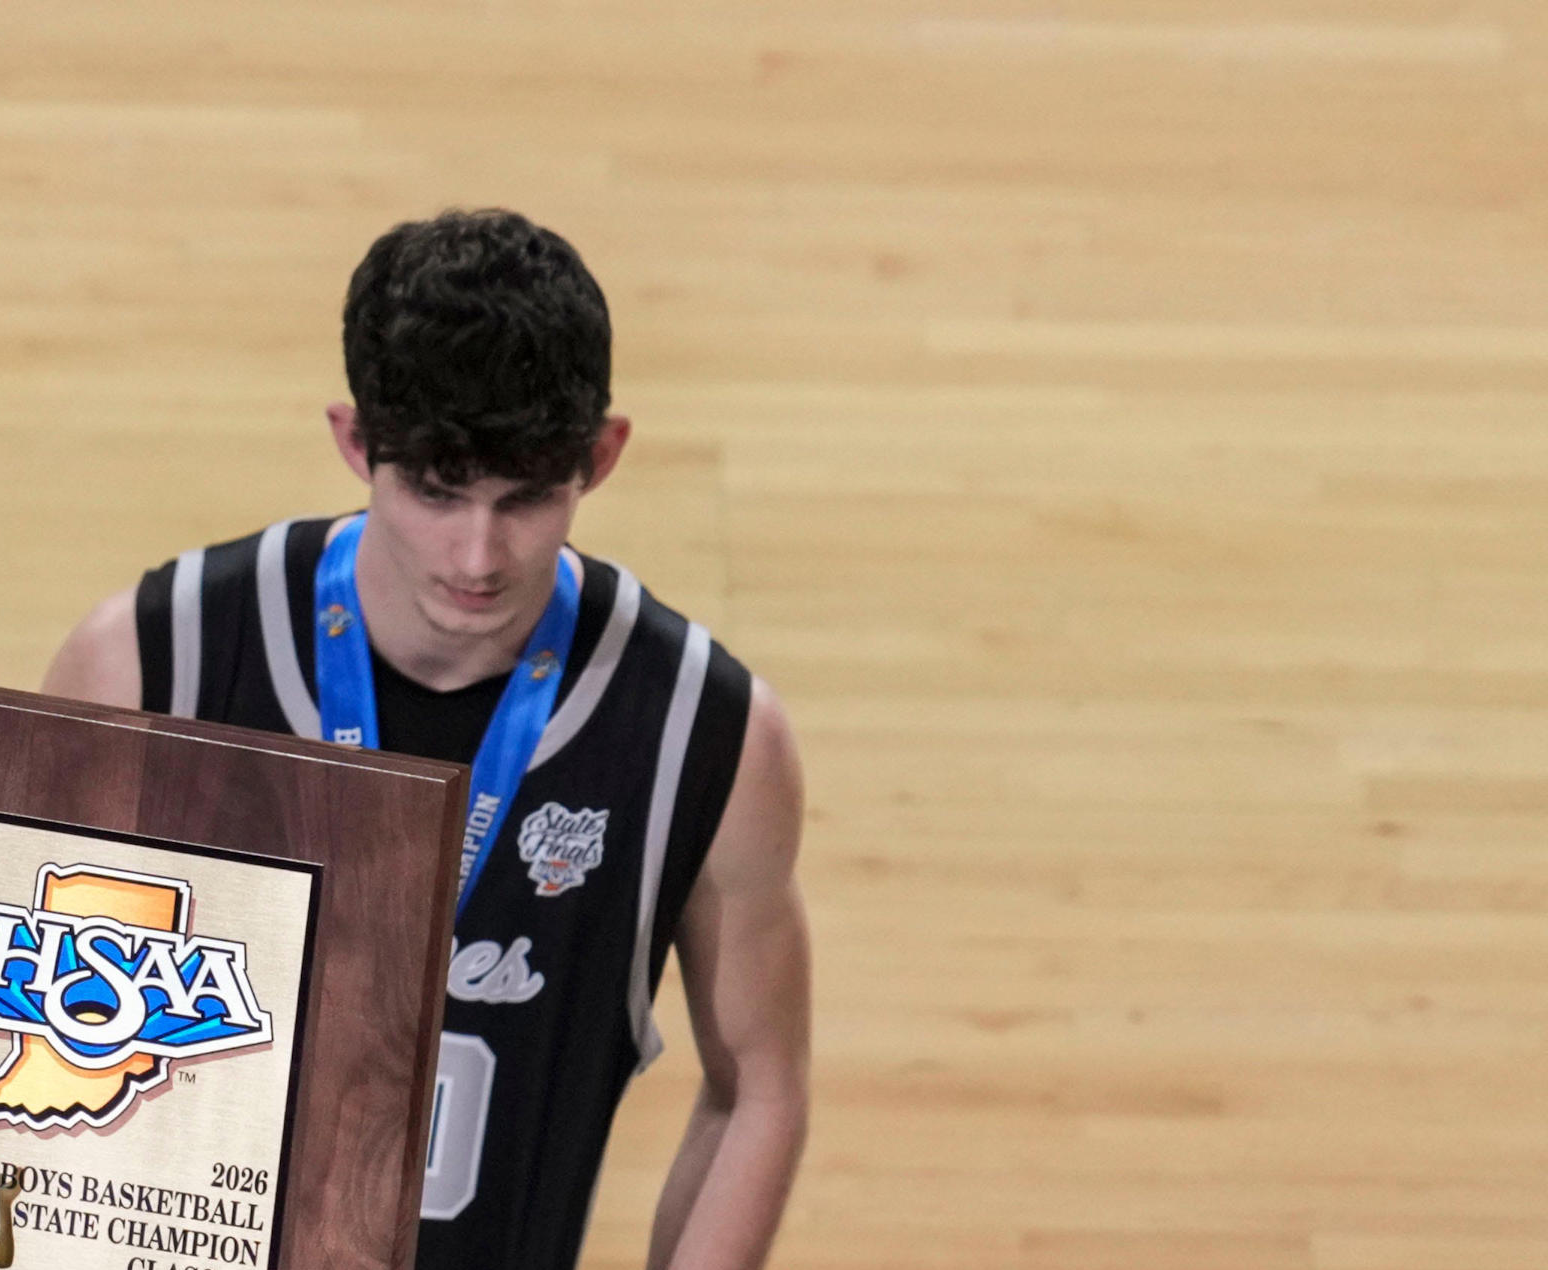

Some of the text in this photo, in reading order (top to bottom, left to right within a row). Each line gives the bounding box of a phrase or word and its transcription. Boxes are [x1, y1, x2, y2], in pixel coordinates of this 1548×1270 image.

[177, 1070, 197, 1085] TM
[1, 1162, 264, 1231] BOYS BASKETBALL
[210, 1162, 269, 1195] 2026
[13, 1201, 261, 1267] STATE CHAMPION
